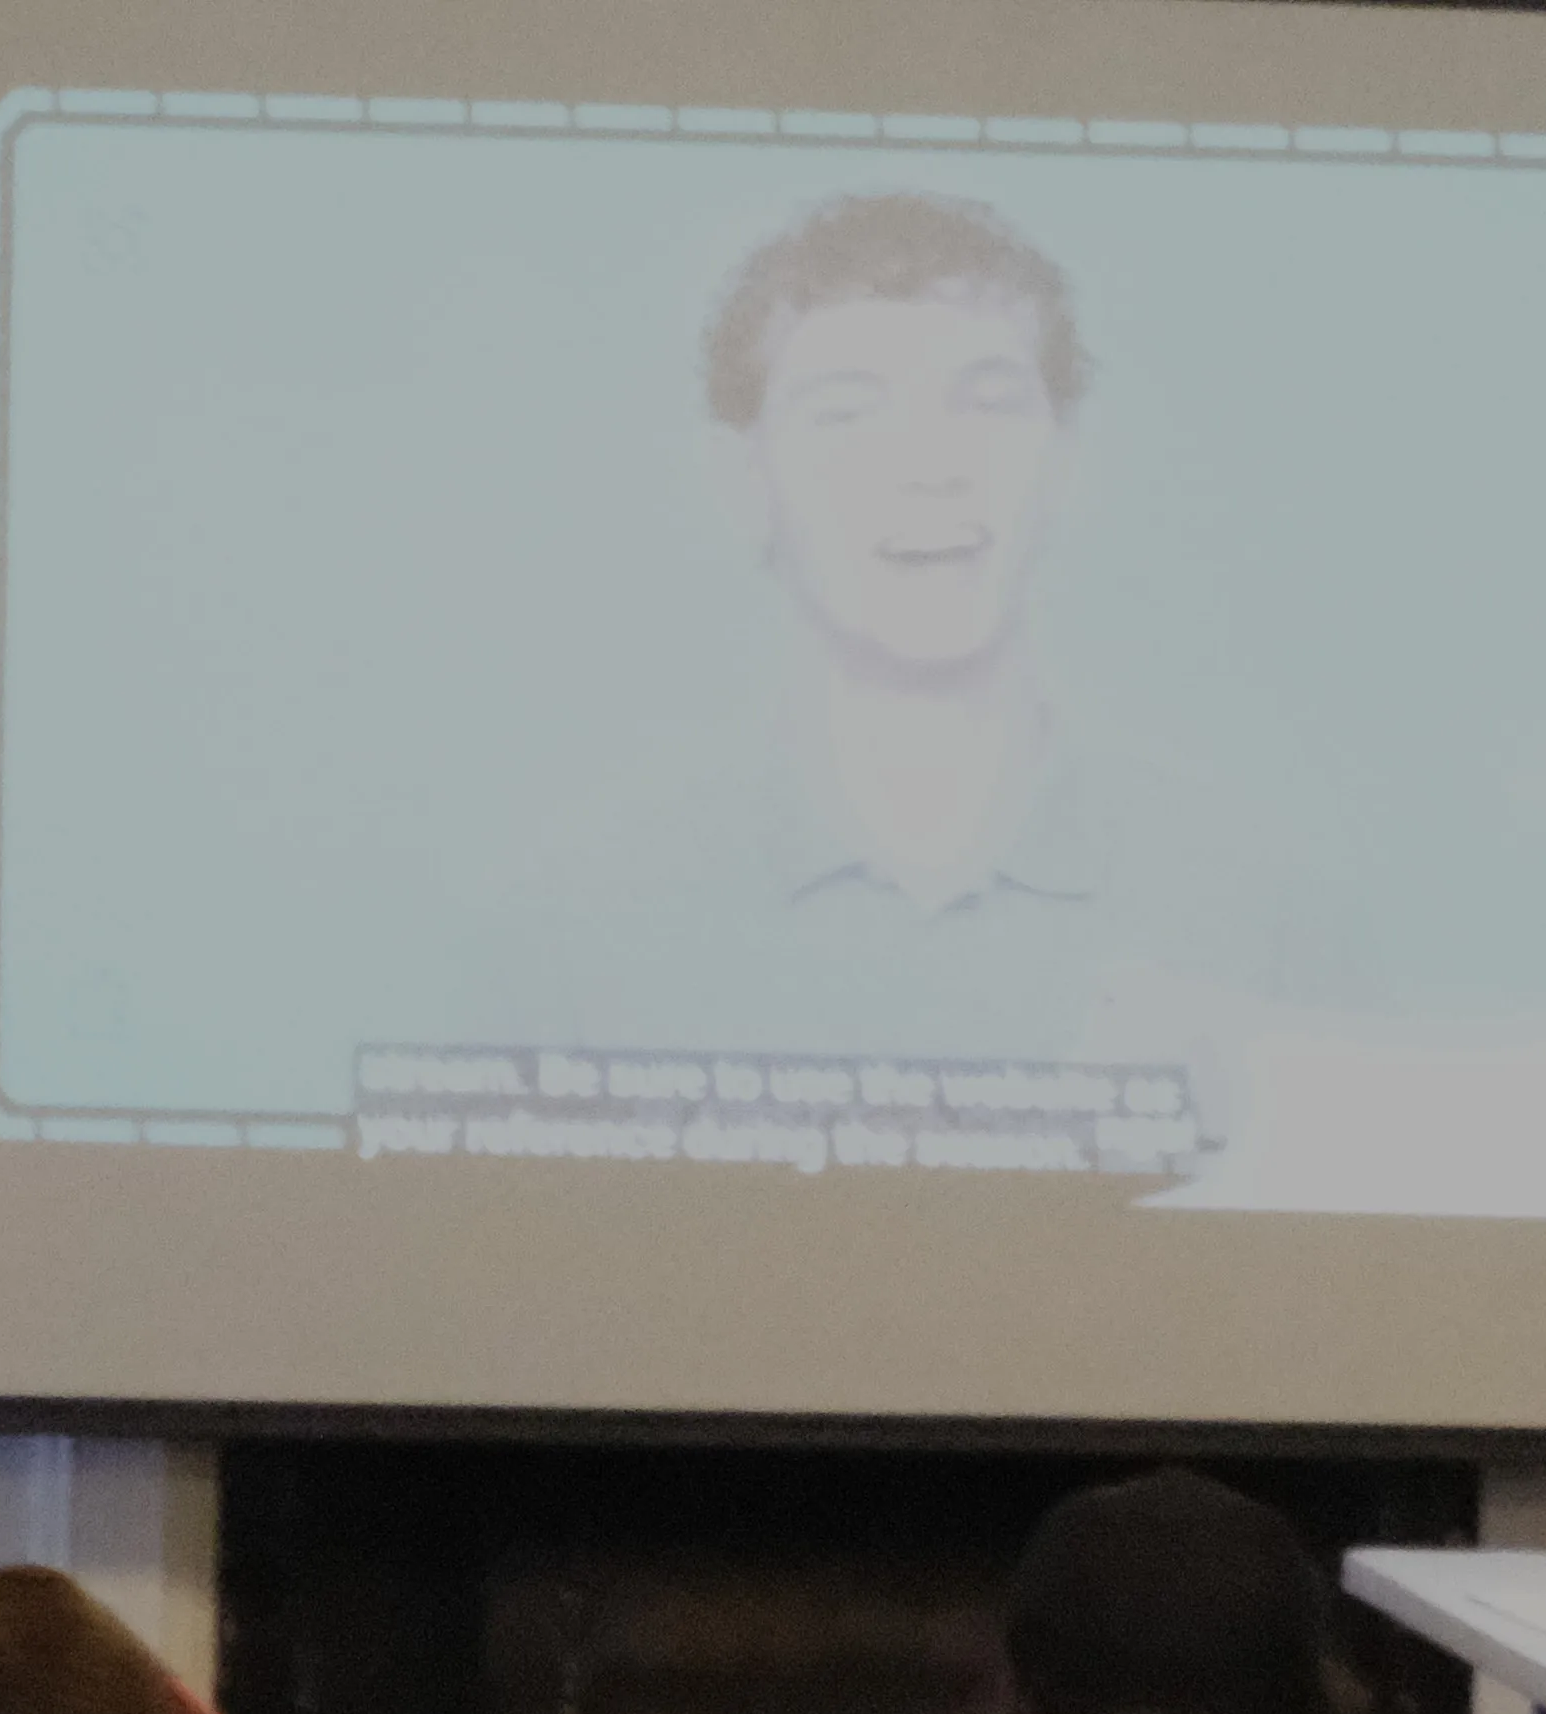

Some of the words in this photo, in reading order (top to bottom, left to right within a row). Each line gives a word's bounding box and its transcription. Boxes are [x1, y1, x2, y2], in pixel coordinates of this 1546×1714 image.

[538, 1052, 599, 1097] Be
[608, 1060, 708, 1099] sure
[714, 1058, 763, 1100] to
[859, 1064, 935, 1106] the
[357, 1115, 459, 1160] your
[833, 1120, 907, 1166] the
